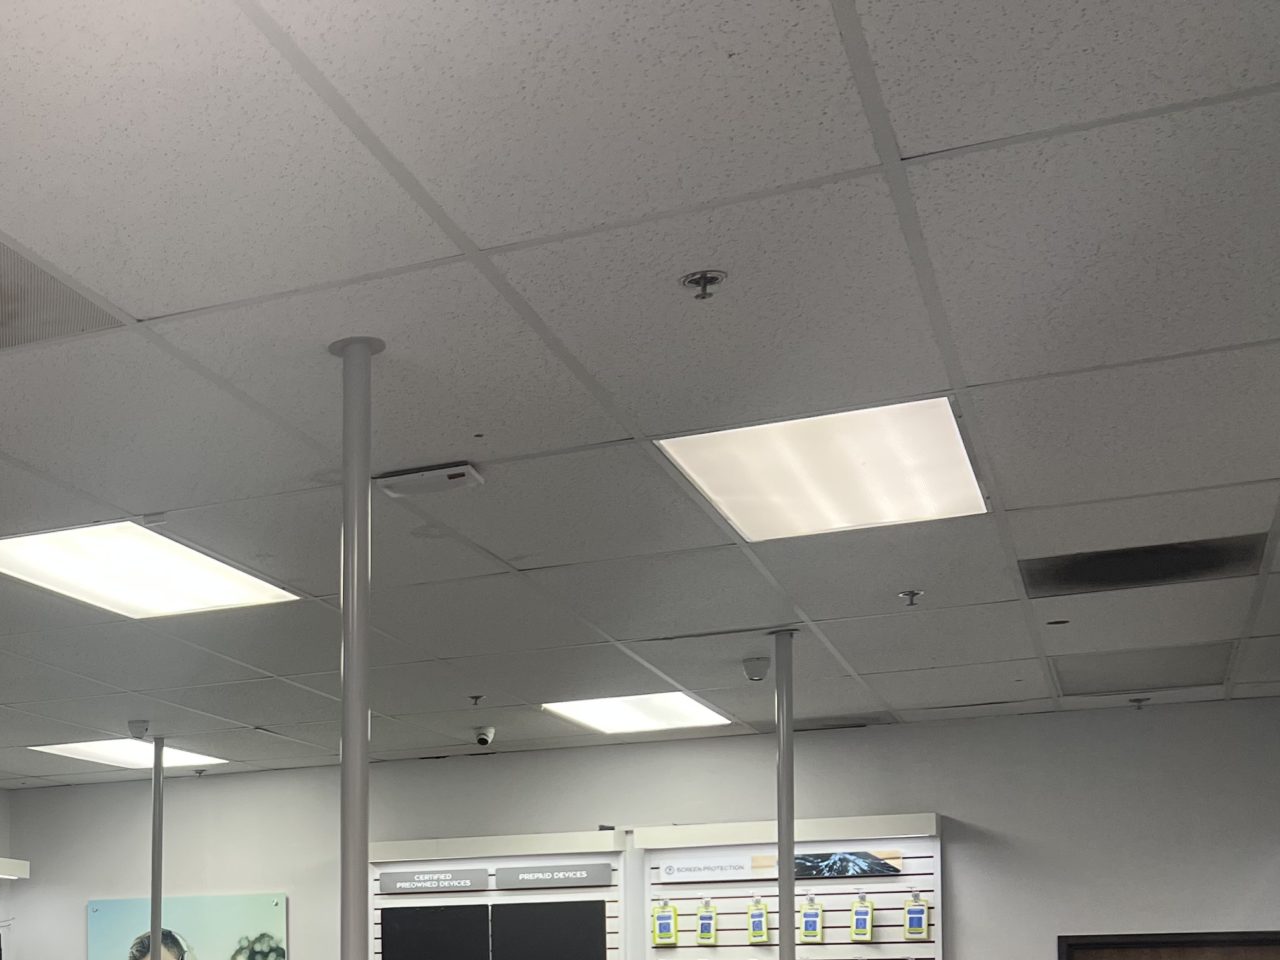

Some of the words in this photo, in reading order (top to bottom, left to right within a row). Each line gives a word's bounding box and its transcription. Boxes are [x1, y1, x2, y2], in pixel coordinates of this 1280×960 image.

[414, 873, 452, 881] CERTIFIED
[518, 872, 552, 880] PREPAID
[553, 870, 588, 879] DEVICES
[396, 881, 438, 889] PREOWNED
[440, 879, 472, 887] DEVICES
